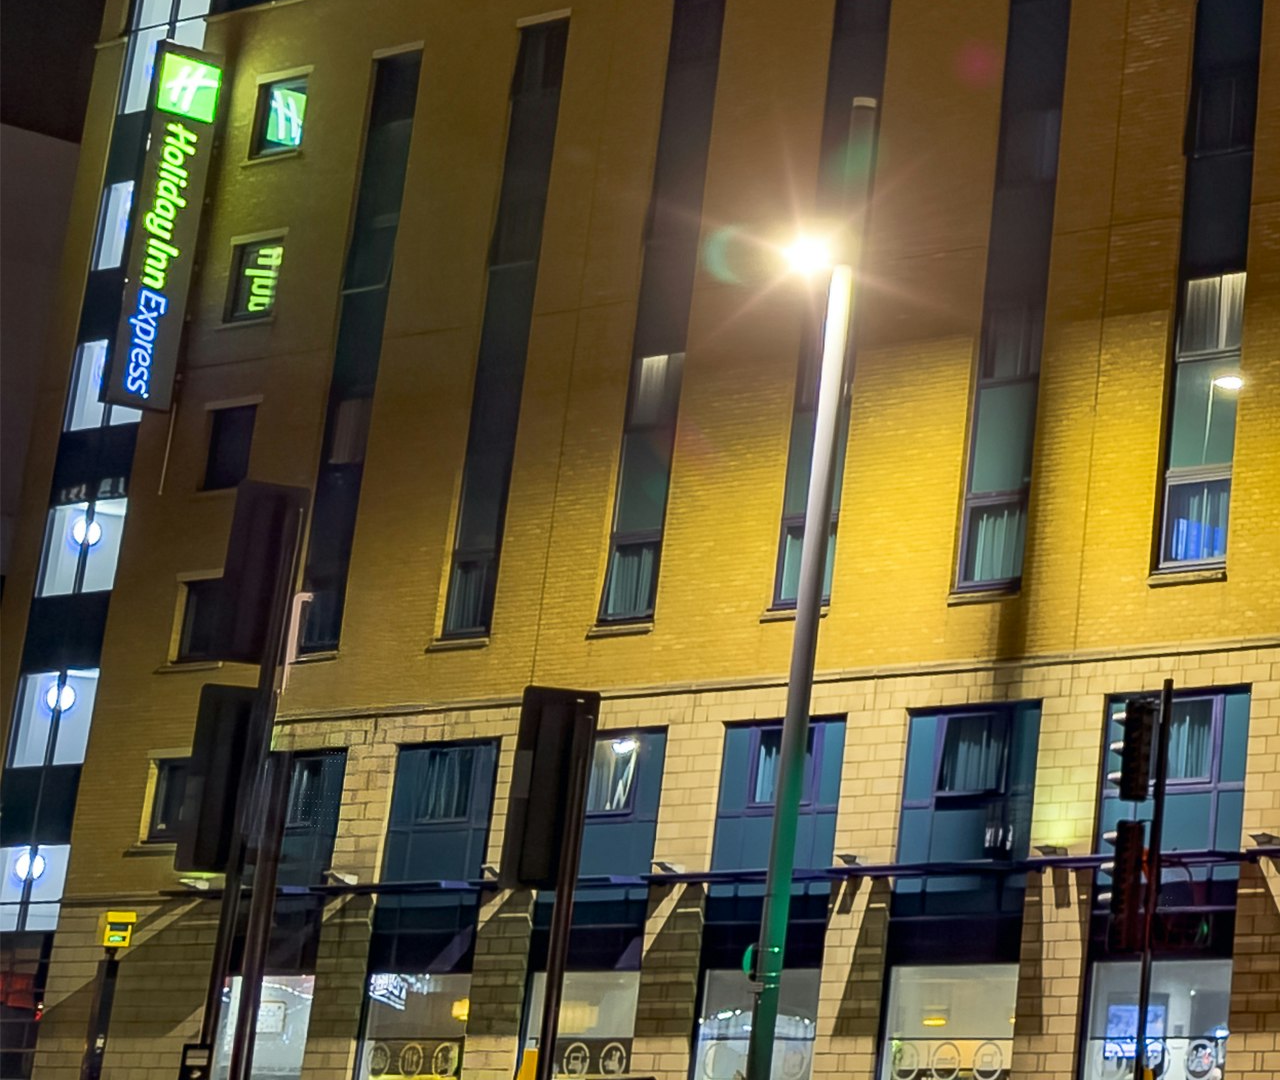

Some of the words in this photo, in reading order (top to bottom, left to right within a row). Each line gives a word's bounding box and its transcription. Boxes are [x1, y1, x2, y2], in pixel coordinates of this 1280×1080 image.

[144, 122, 199, 241] Holiday
[141, 238, 180, 290] Inn
[126, 290, 168, 393] Express
